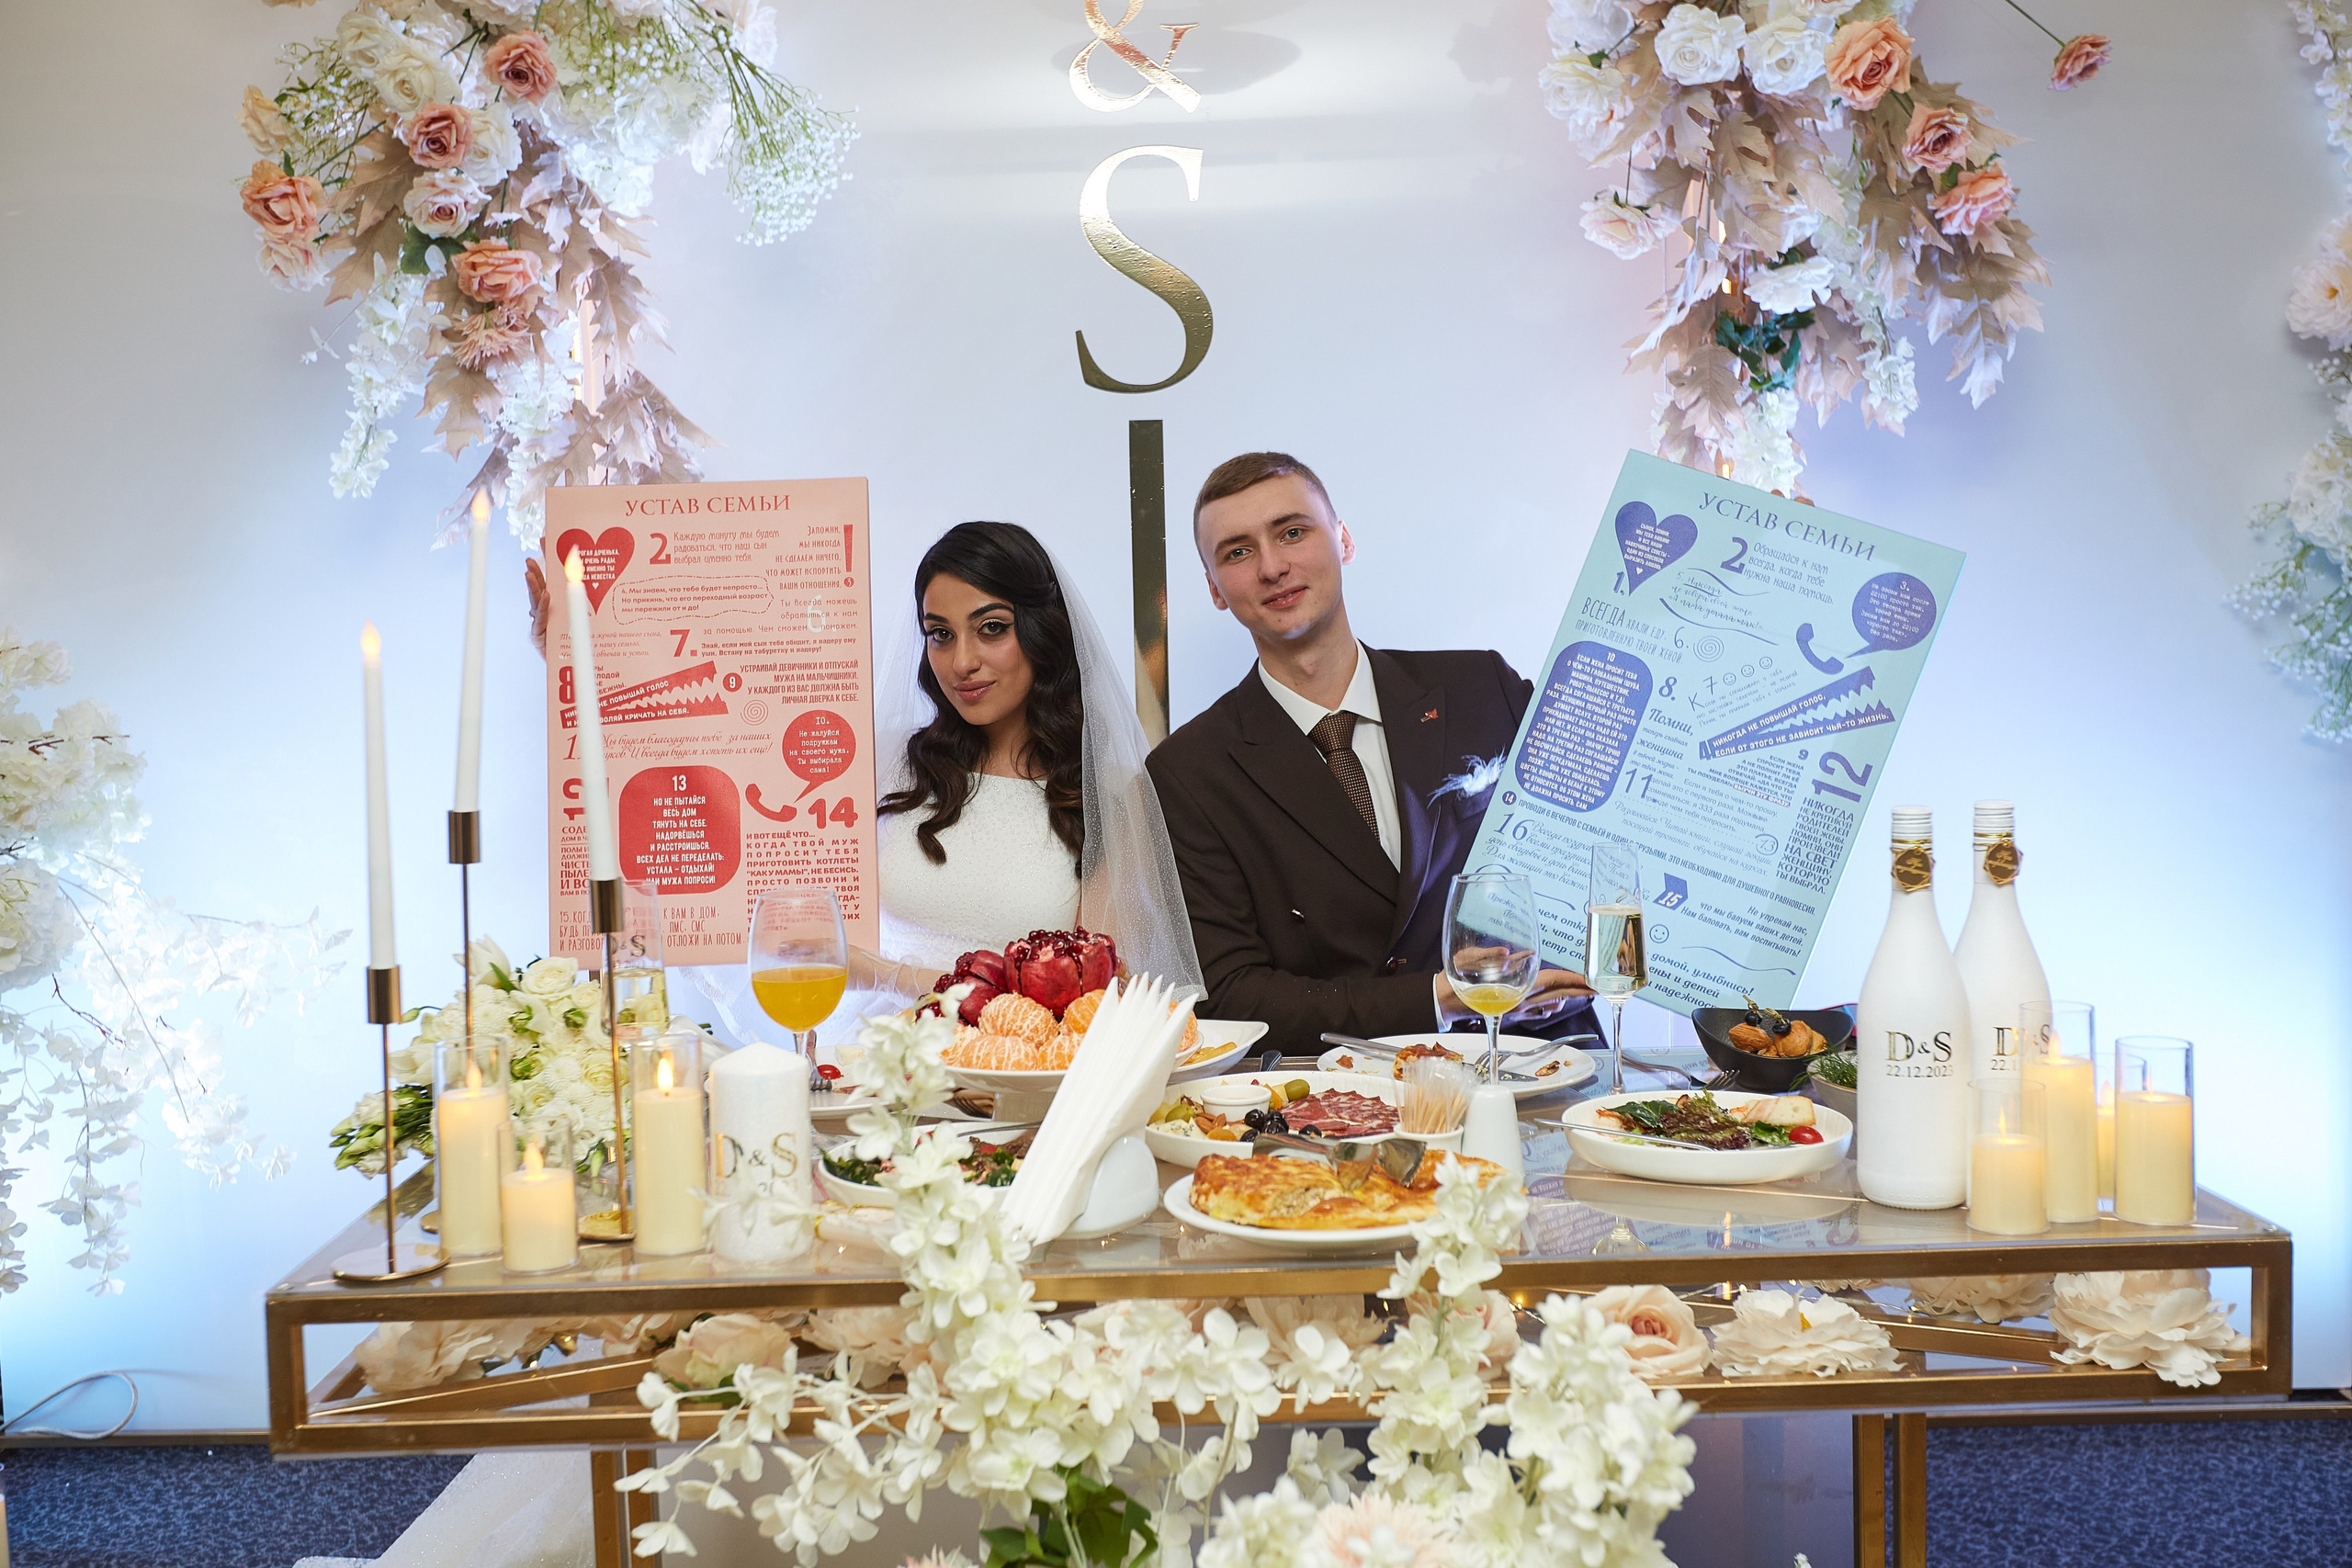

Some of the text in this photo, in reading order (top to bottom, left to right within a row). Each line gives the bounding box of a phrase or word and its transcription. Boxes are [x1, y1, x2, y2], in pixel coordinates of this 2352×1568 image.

[1076, 145, 1214, 393] S
[625, 494, 789, 516] УСТАВ СЕМЬИ
[673, 528, 779, 542] Каждую минуту мы будем
[1699, 491, 1875, 561] УСТАВ СЕМЬИ
[649, 532, 671, 565] 2
[734, 542, 750, 550] наш
[811, 539, 841, 547] НИКОГДА
[673, 552, 752, 566] выбрал именно тебя.
[785, 554, 813, 562] СДЕЛАЕМ
[1719, 536, 1747, 574] 2
[1753, 542, 1828, 575] Обращайся к нам
[765, 566, 841, 577] ЧТО МОЖЕТ ИСПОРТИТЬ
[1743, 568, 1770, 583] нужна
[1772, 578, 1795, 592] наша
[1778, 566, 1803, 580] когда
[1806, 574, 1825, 587] тебе
[779, 581, 797, 590] ВАШИ
[1581, 596, 1625, 627] ВСЕГДА
[1625, 618, 1649, 635] ХВАЛИ
[740, 659, 858, 672] УСТРАИВАЙ ДЕВИЧНИКИ И ОТПУСКАЙ
[1606, 651, 1615, 662] 10
[729, 676, 735, 688] 9
[774, 673, 795, 682] МУЖА
[796, 673, 805, 682] НА
[747, 682, 859, 694] У КАЖДОГО ИЗ ВАС ДОЛЖНА БЫТЬ
[781, 694, 808, 704] ЛИЧНАЯ
[808, 694, 834, 704] ДВЕРКА
[835, 694, 840, 702] К
[1648, 708, 1693, 737] Помни,
[1713, 694, 1827, 748] НИКОГДА НЕ ПОВЫШАЙ ГОЛОС,
[1714, 714, 1889, 757] ЕСЛИ ОТ ЭТОГО НЕ ЗАВИСИТ ЧЬЯ-ТО ЖИЗНЬ.
[1634, 739, 1683, 760] женщина
[672, 774, 686, 791] 13
[1624, 768, 1653, 799] 11
[1812, 750, 1873, 804] 12
[653, 795, 706, 806] НО НЕ ПЫТАЙСЯ
[1504, 793, 1514, 803] 14
[662, 807, 696, 818] ВЕСЬ ДОМ
[807, 796, 858, 829] 14
[1799, 806, 1810, 815] НЕ
[1802, 796, 1853, 822] НИКОГДА
[652, 819, 677, 829] ТЯНУТЬ
[679, 819, 688, 828] НА
[1493, 812, 1534, 841] 16
[1794, 821, 1819, 835] ТВОЕЙ
[1796, 813, 1849, 838] РОДИТЕЛЕЙ
[650, 843, 654, 852] И
[746, 838, 858, 849] КОГДА ТВОЙ МУЖ
[746, 847, 858, 858] ПОПРОСИТ ТЕБЯ
[1759, 839, 1775, 852] 13
[1788, 834, 1840, 860] ПРОИЗВЕЛИ
[1825, 840, 1843, 852] ОНИ
[636, 854, 653, 863] ВСЕХ
[655, 853, 669, 864] ДЕЛ
[671, 853, 679, 862] НЕ
[746, 856, 859, 867] ПРИГОТОВИТЬ КОТЛЕТЫ
[1783, 842, 1838, 869] НА СВЕТ
[646, 865, 673, 874] УСТАЛА
[1776, 861, 1831, 886] КОТОРУЮ
[1781, 852, 1832, 879] ЖЕНЩИНУ,
[746, 878, 789, 886] ПРОСТО
[796, 875, 846, 885] ПОЗВОНИ
[1668, 854, 1815, 915] ЭТО НЕОБХОДИМО ДЛЯ ДУШЕВНОГО РАВНОВЕСИЯ.
[1775, 870, 1826, 895] ТЫ ВЫБРАЛ.
[1657, 889, 1679, 907] 15
[1700, 902, 1712, 911] что
[1713, 908, 1725, 916] мы
[1726, 911, 1754, 927] балуем
[1754, 923, 1780, 937] ваших
[1747, 905, 1758, 916] Не
[1758, 911, 1792, 929] упрекай
[1679, 906, 1697, 919] Нам
[1734, 928, 1749, 938] вам
[1750, 934, 1801, 957] воспитывать!
[1650, 953, 1754, 1000] домой, улыбнись!
[1885, 1031, 1953, 1063] D&S
[1886, 1064, 1954, 1078] 22.12.2023
